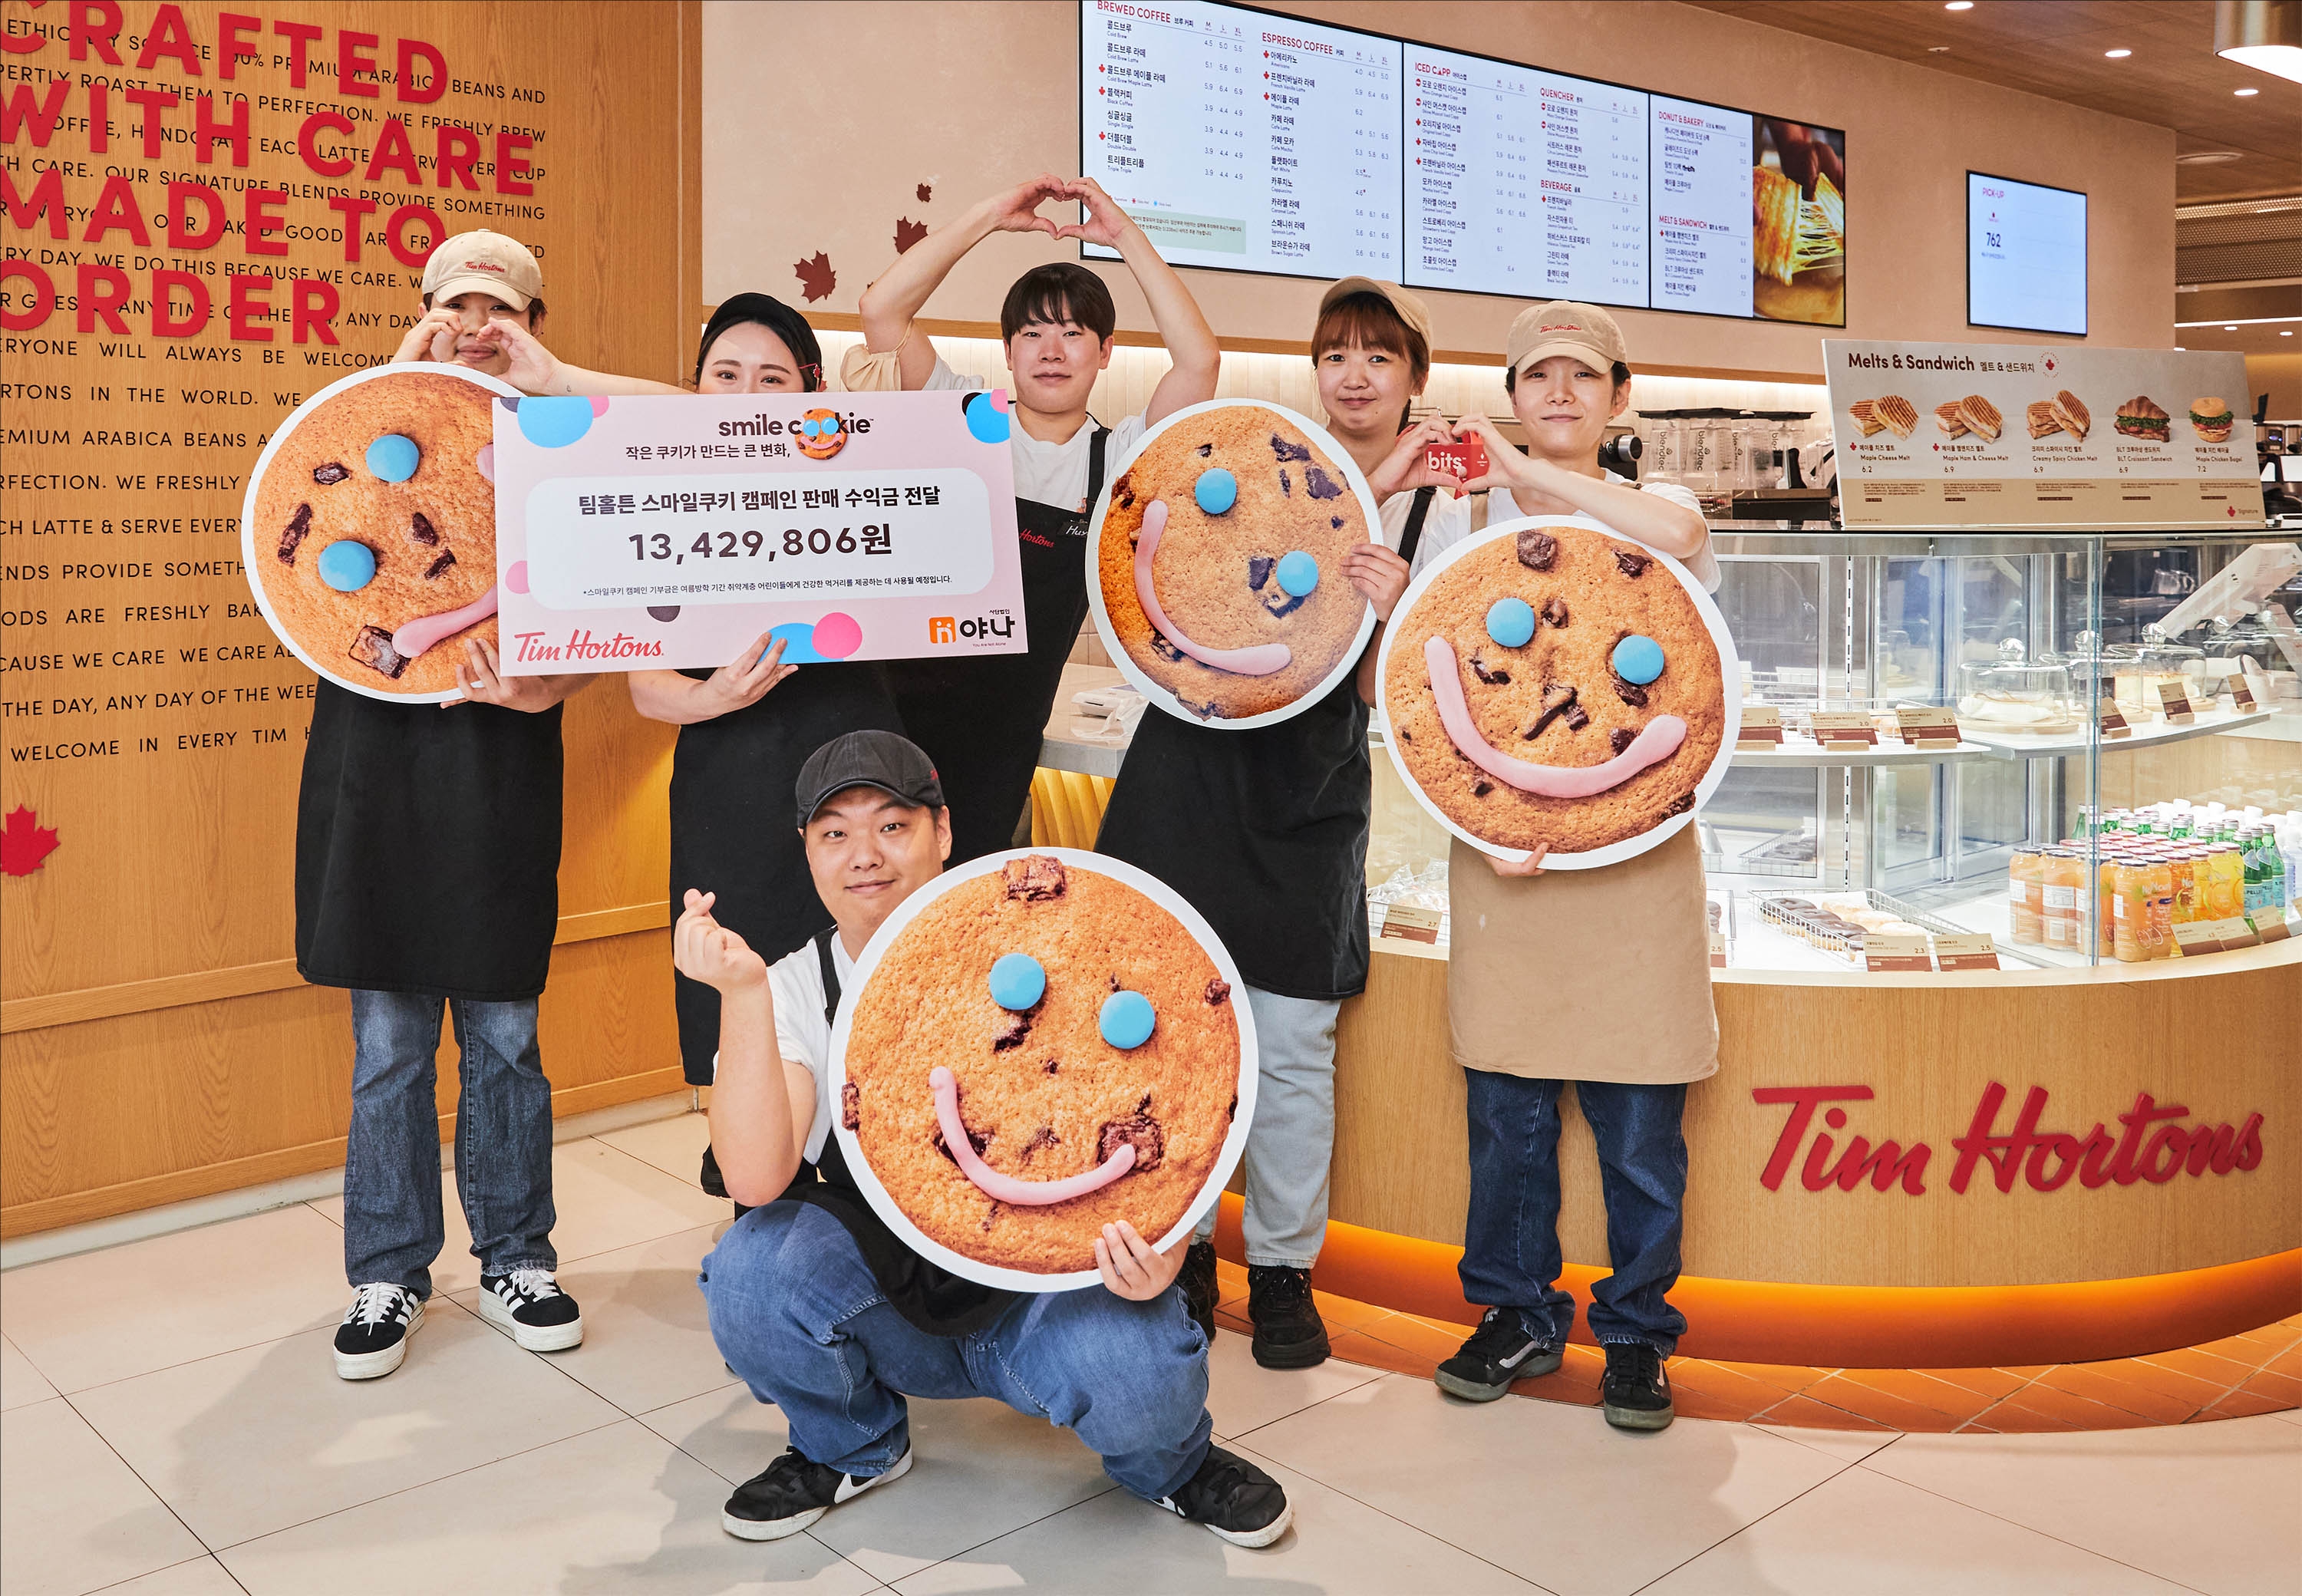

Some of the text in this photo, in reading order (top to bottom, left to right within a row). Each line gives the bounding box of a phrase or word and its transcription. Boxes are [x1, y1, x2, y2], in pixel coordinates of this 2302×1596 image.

[1097, 1, 1171, 23] BREWED COFFEE
[1107, 20, 1132, 31] 콜드브루
[1107, 42, 1146, 58] 콜드브루 라떼
[1262, 32, 1333, 54] ESPRESSO COFFEE
[1271, 51, 1298, 64] 아메리카노
[1107, 65, 1166, 83] 콜드브루 메이플 라떼
[1415, 62, 1430, 74] ICED
[453, 79, 546, 104] BEANS AND
[1107, 87, 1132, 100] 블랙커피
[1540, 87, 1574, 102] QUENCHER
[157, 83, 213, 101] THEM
[259, 97, 378, 123] PERFECTION.
[422, 115, 493, 135] FRESHLY
[1107, 110, 1132, 122] 싱글싱글
[0, 80, 533, 196] WITH CARE
[1107, 133, 1132, 144] 더블더블
[1107, 155, 1144, 168] 트리플트리플
[32, 159, 546, 219] CARE. OUR SIGNATURE BLENDS PROVIDE SOMETHING
[1271, 177, 1293, 187] 카푸치노
[1541, 180, 1572, 193] BEVERAGE
[1982, 187, 2005, 199] PICK-UP
[0, 164, 446, 268] MADE TO
[1986, 232, 2001, 248] 762
[172, 259, 402, 288] THIS BECAUSE WE CARE.
[465, 262, 477, 270] Tim
[0, 259, 340, 345] ORDER
[346, 312, 381, 327] ANY
[100, 342, 285, 364] WILL ALWAYS BE
[1849, 353, 2035, 373] Melts & Sandwich 멜트 & 샌드위치
[91, 387, 110, 401] IN
[127, 388, 165, 403] THE
[181, 390, 259, 405] WORLD.
[274, 393, 301, 406] WE
[718, 414, 783, 437] smile
[82, 431, 246, 447] ARABICA BEANS
[625, 443, 791, 460] 작은 쿠키가 만드는 큰 변화,
[1428, 451, 1462, 470] bits
[1658, 431, 1667, 471] blendtec
[1697, 431, 1706, 471] blendtec
[116, 476, 239, 490] WE FRESHLY
[579, 485, 941, 515] 팀홀튼 스마일쿠키 캠페인 판매 수익금 전달
[33, 519, 182, 536] LATTE & SERVE
[628, 523, 892, 566] 13,429,806원
[1019, 529, 1055, 548] Hortons
[63, 562, 153, 579] PROVIDE
[625, 586, 648, 595] 캠페인
[650, 585, 678, 594] 기부금은
[681, 584, 709, 593] 여름방학
[711, 583, 726, 592] 기간
[727, 582, 756, 592] 취약계층
[758, 580, 800, 590] 어린이들에게
[803, 579, 823, 589] 건강한
[825, 579, 853, 588] 먹거리를
[855, 577, 883, 587] 제공하는
[885, 577, 892, 585] 데
[893, 576, 914, 585] 사용될
[915, 575, 952, 585] 예정입니다.
[66, 608, 105, 625] ARE
[125, 605, 210, 622] FRESHLY
[960, 615, 1015, 639] 야나
[514, 628, 663, 662] Tim Hortons
[73, 645, 266, 668] WE CARE WE CARE
[2, 687, 270, 718] THE DAY, ANY DAY OF THE
[11, 727, 287, 762] WELCOME IN EVERY TIM
[1752, 1080, 2264, 1196] Tim Hortons
